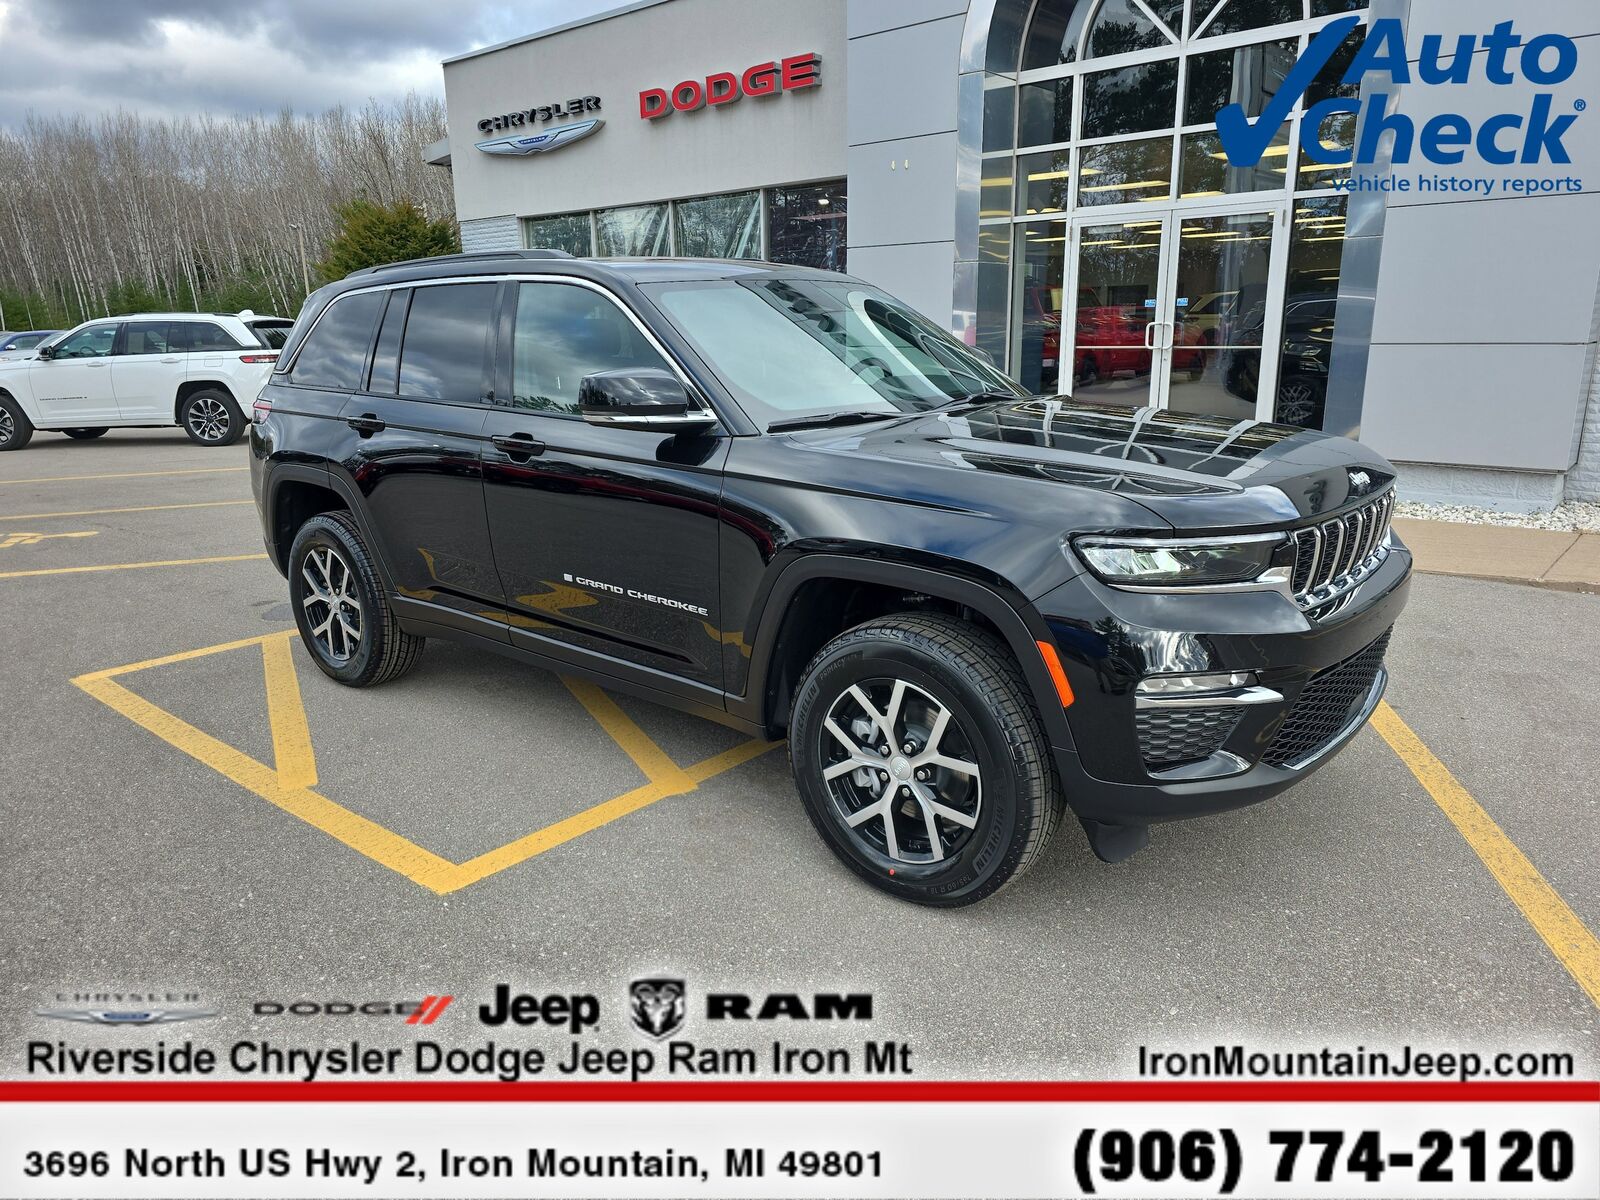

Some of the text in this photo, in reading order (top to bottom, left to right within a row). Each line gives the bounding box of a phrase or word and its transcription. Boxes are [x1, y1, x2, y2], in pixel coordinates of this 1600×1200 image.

[638, 52, 822, 120] DODGE
[476, 94, 602, 134] CHRYSLER
[575, 575, 709, 617] GRAND CHEROKEE
